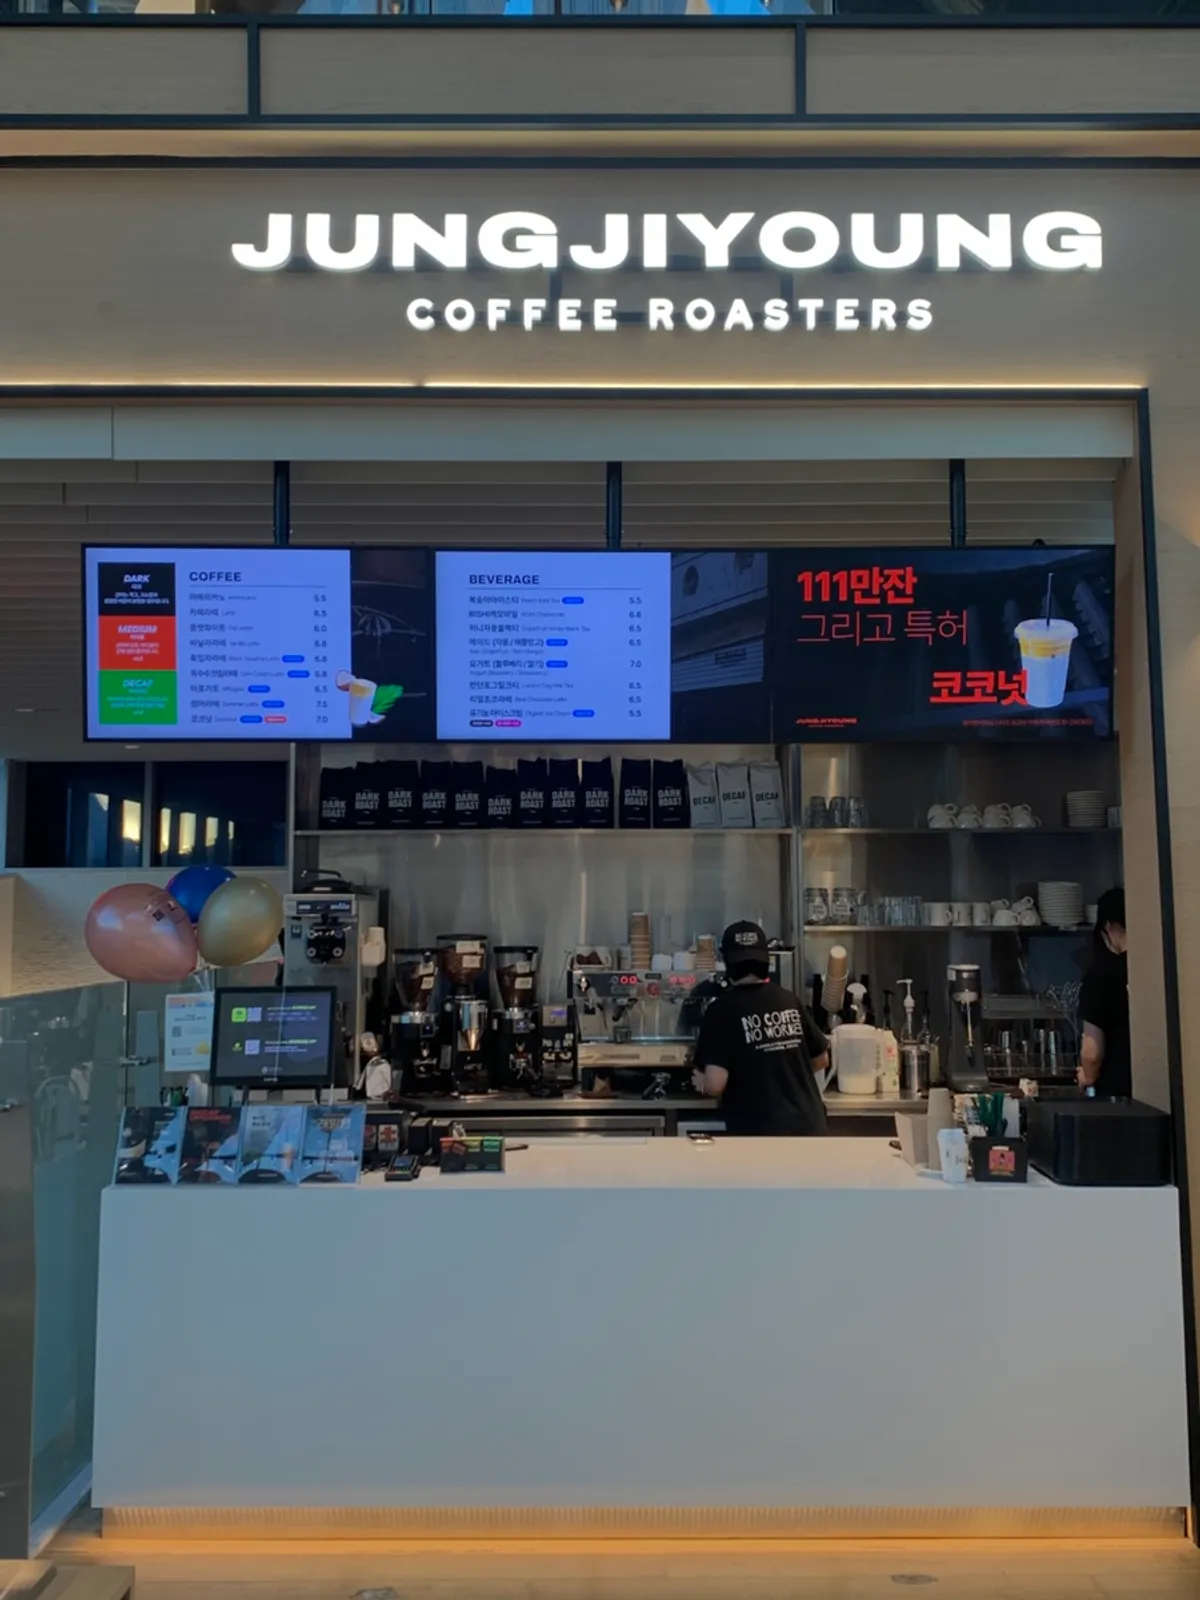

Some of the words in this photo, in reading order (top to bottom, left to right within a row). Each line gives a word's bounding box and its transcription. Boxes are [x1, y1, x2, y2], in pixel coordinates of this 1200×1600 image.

[233, 212, 1101, 269] JUNGJIYOUNG
[407, 299, 616, 330] COFFEE
[650, 299, 931, 329] ROASTERS
[123, 574, 150, 583] DARK
[188, 571, 242, 582] COFFEE
[469, 574, 540, 585] BEVERAGE
[798, 567, 917, 604] 111만잔
[797, 610, 896, 647] 그리고
[904, 609, 969, 646] 특허
[929, 668, 1028, 706] 코코넛
[355, 792, 380, 801] DARK
[388, 791, 412, 799] DARK
[422, 792, 446, 800] DARK
[455, 793, 479, 802] DARK
[520, 791, 544, 800] DARK
[552, 791, 576, 799] DARK
[585, 791, 609, 799] DARK
[624, 789, 648, 797] DARK
[658, 789, 681, 798] DARK
[322, 801, 346, 809] DARK
[488, 798, 512, 806] DARK
[741, 1014, 761, 1031] NO
[745, 1028, 763, 1044] NO
